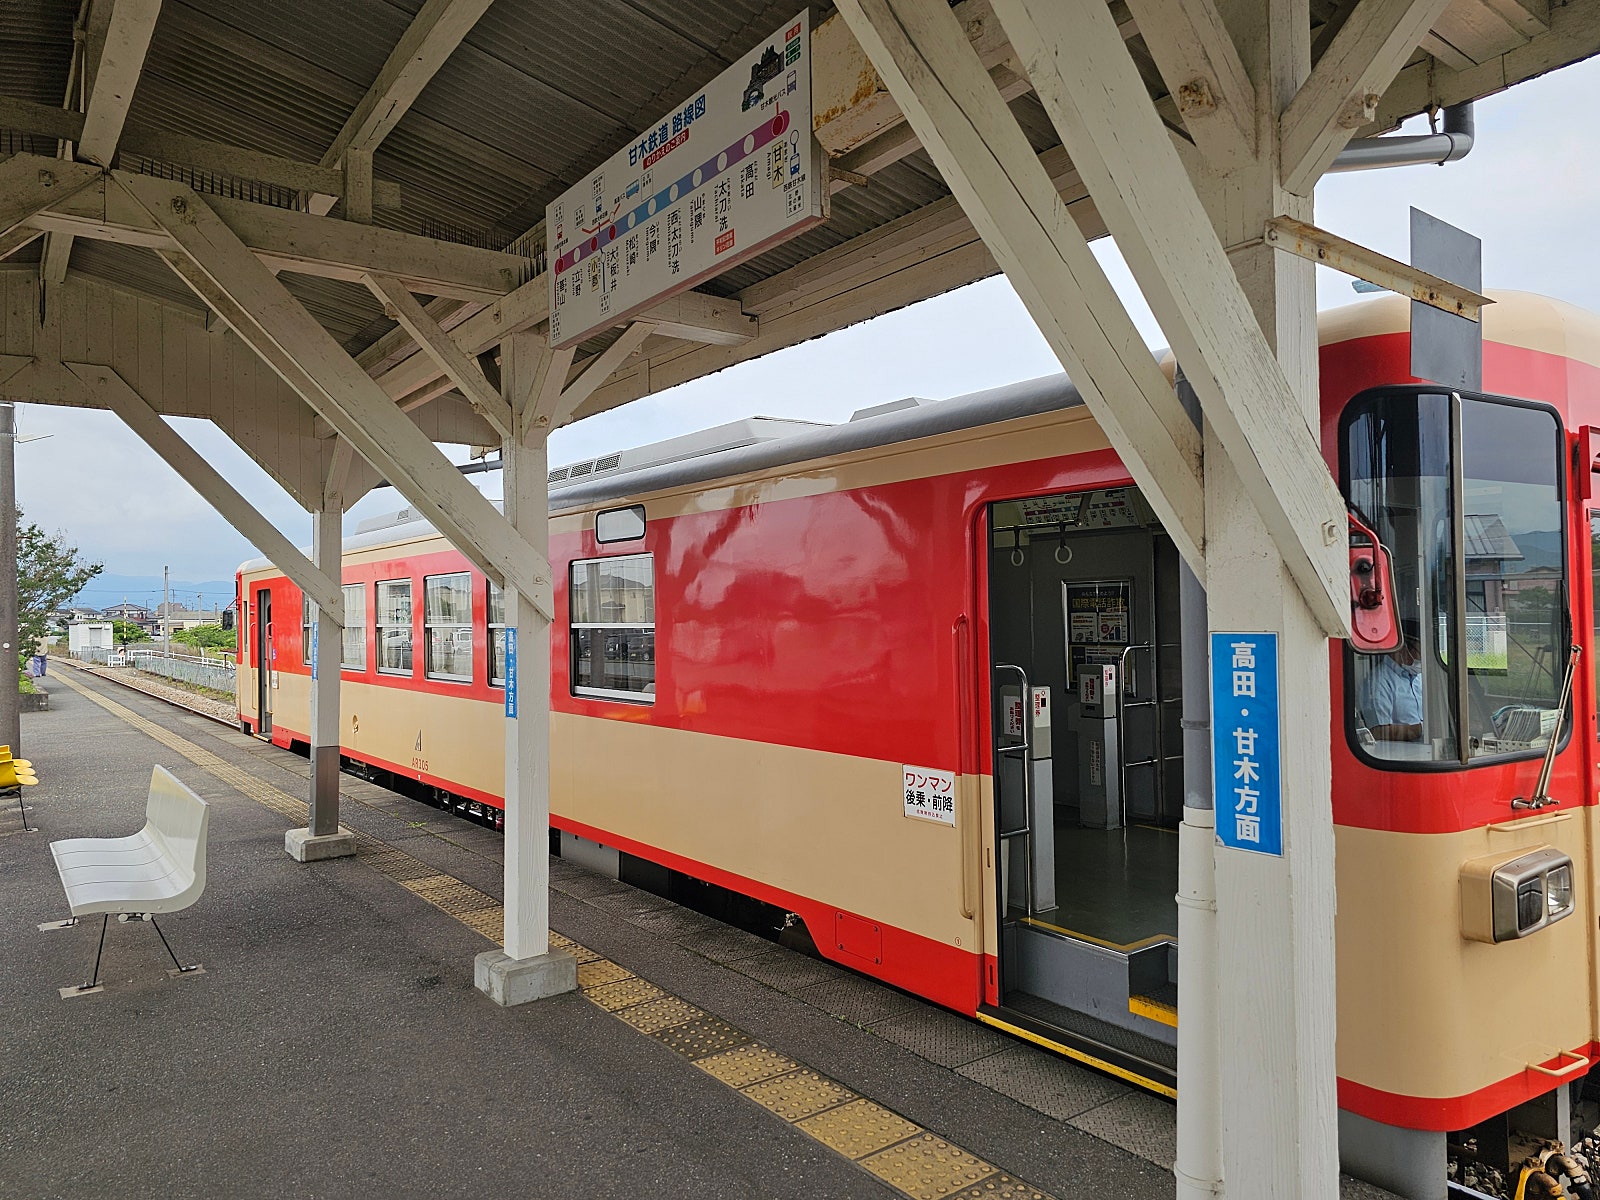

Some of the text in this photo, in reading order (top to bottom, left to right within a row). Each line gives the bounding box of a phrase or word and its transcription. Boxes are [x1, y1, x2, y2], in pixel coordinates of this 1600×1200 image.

[629, 94, 705, 167] 甘木鉄道 路線図
[646, 132, 686, 166] のりかえのご案内
[773, 145, 783, 181] 甘木
[745, 163, 754, 199] 高田
[694, 196, 702, 229] 山隈
[719, 180, 728, 232] 太刀洗
[649, 224, 657, 255] 今隈
[670, 210, 680, 274] 西太刀洗
[1231, 642, 1260, 843] 高田・甘木方面
[905, 772, 952, 793] ワンマン
[905, 789, 953, 813] 後乗・前降
